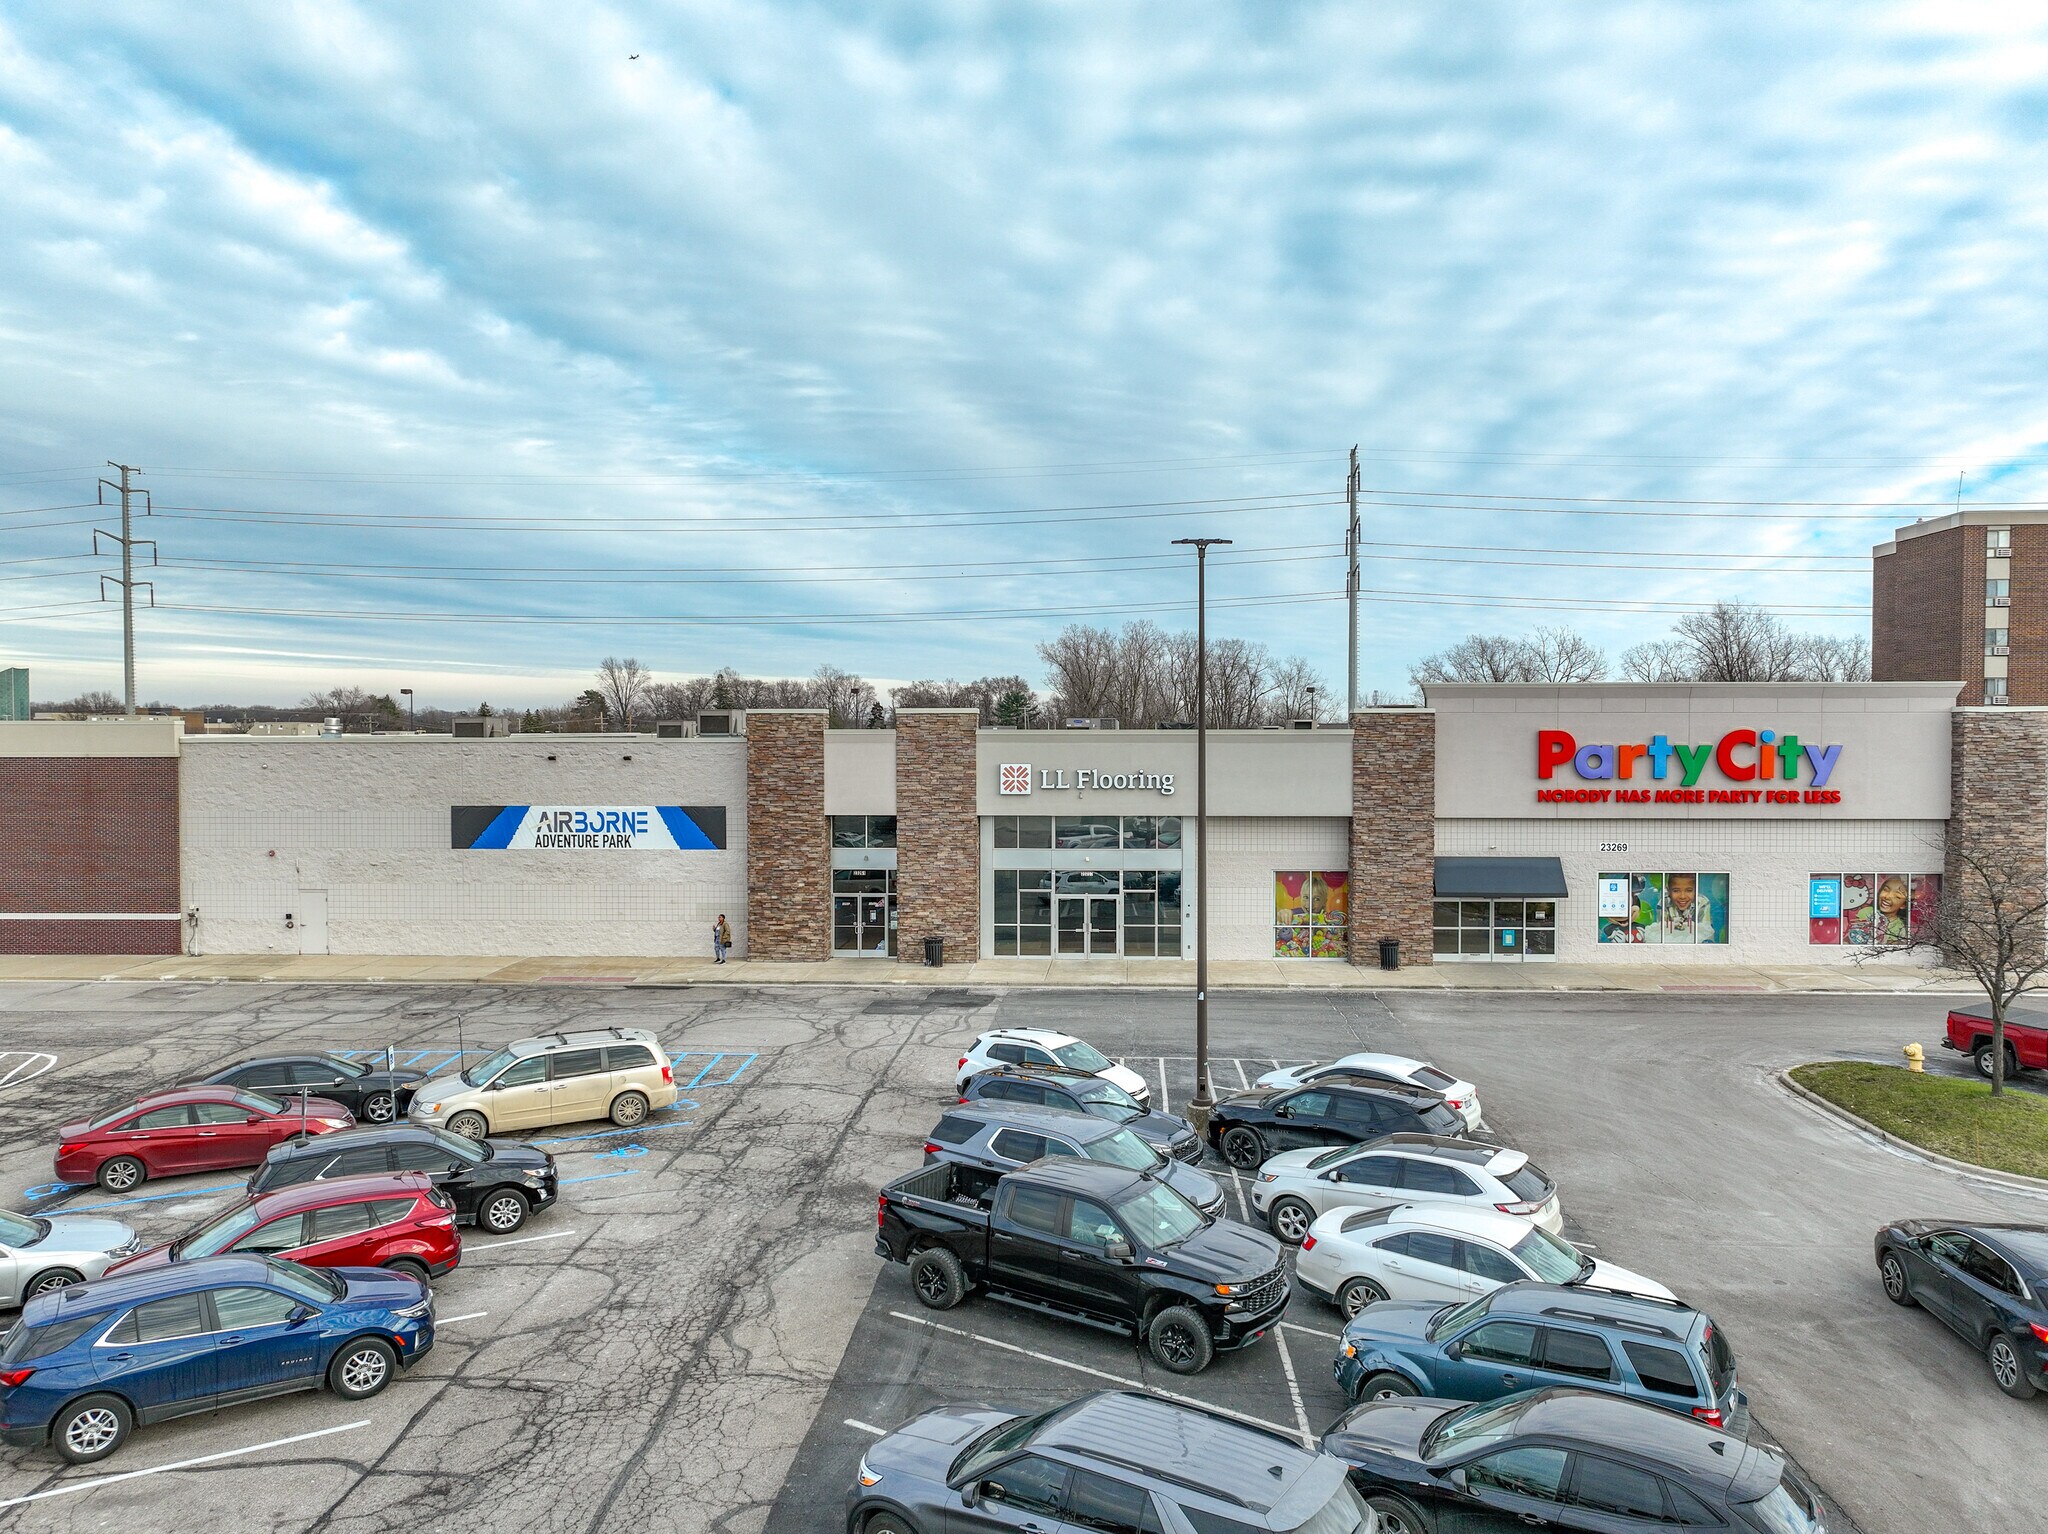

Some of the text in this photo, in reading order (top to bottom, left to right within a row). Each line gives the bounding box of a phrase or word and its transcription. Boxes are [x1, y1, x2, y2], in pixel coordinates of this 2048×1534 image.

[1040, 768, 1175, 796] LL Flooring
[1537, 789, 1842, 803] NOBODY HAS MORE PARTY FOR LESS
[536, 811, 648, 837] AIRBORNE
[535, 834, 632, 848] ADVENTURE PARK
[1600, 842, 1628, 852] 23269
